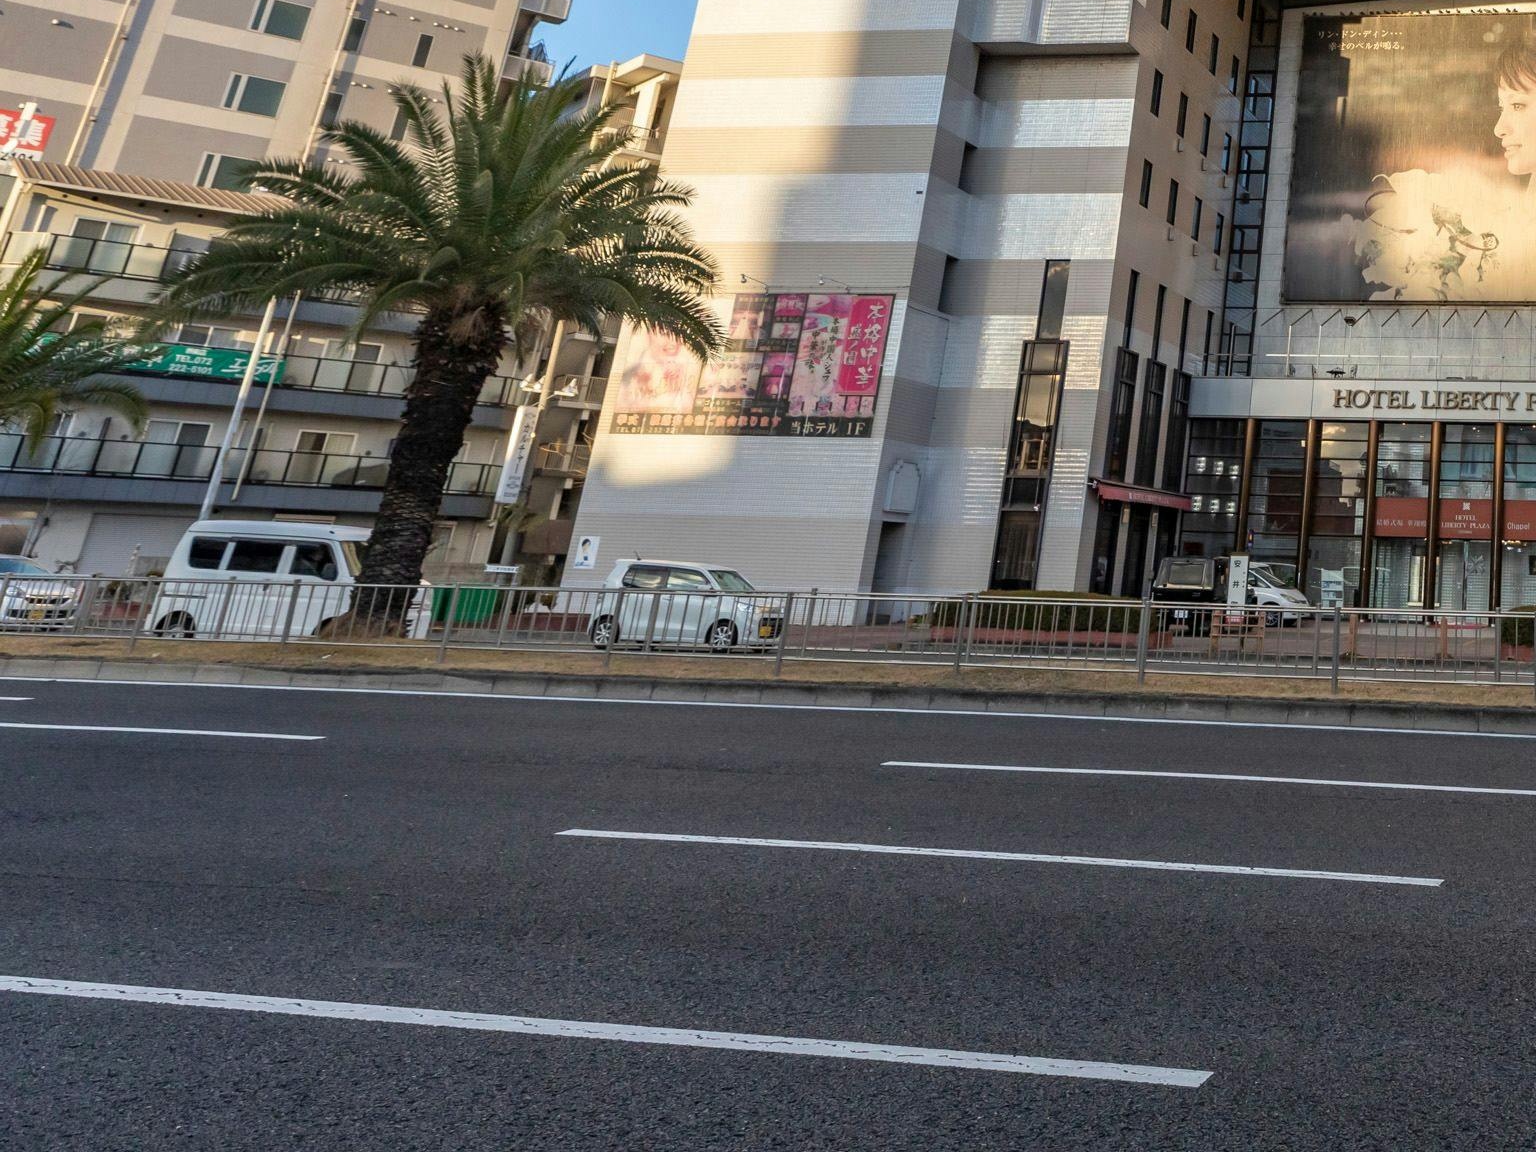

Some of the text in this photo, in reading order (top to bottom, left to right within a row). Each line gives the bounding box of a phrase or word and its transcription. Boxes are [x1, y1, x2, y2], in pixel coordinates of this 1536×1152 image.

[854, 302, 885, 388] 本格中華
[1333, 389, 1415, 410] HOTEL
[1420, 390, 1520, 412] LIBERTY
[791, 421, 838, 435] 当ホテル
[1507, 522, 1530, 531] Chapel
